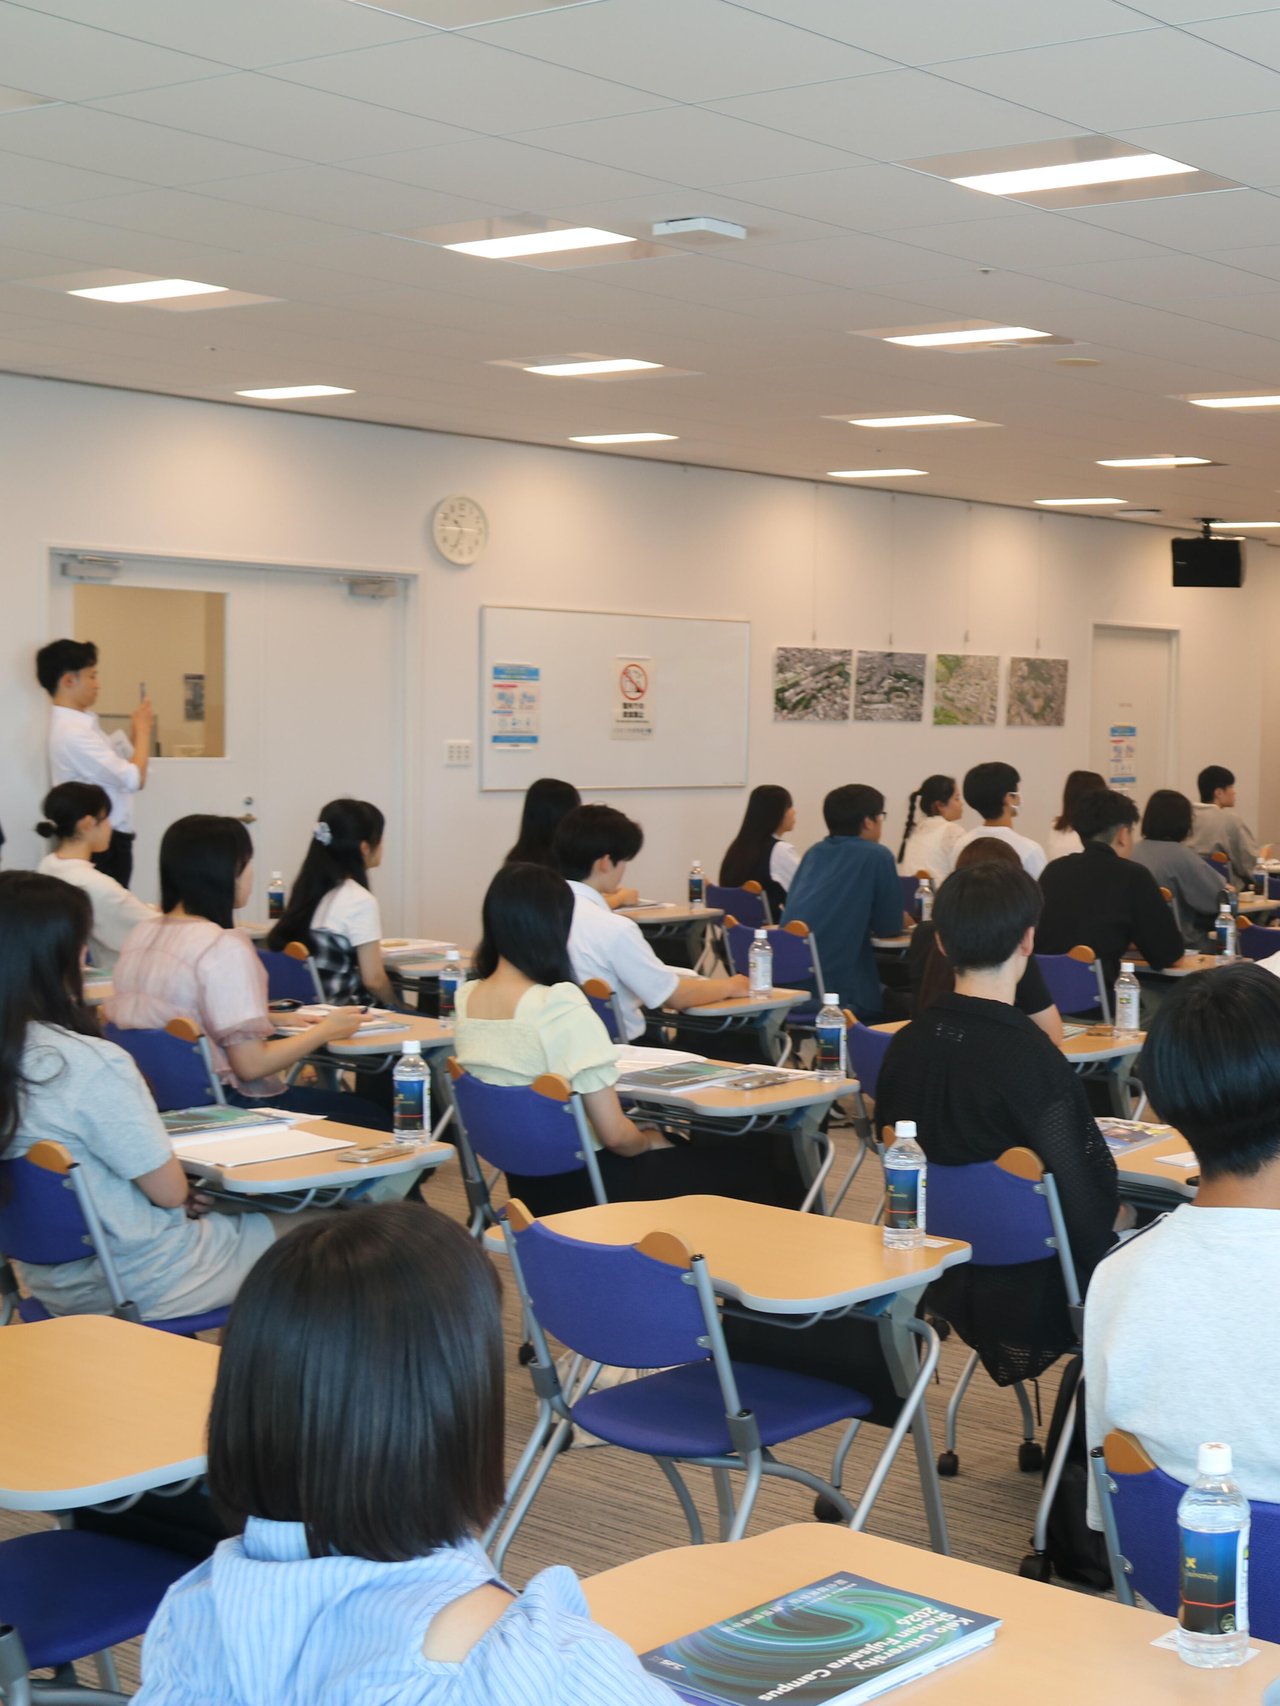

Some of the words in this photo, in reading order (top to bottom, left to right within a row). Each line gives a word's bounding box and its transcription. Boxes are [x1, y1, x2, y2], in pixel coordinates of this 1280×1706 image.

[895, 1606, 941, 1626] 2026
[896, 1611, 960, 1641] Shonan
[935, 1616, 976, 1635] Keio
[825, 1634, 904, 1670] Fujisawa
[854, 1631, 937, 1671] University
[757, 1667, 832, 1702] Campus
